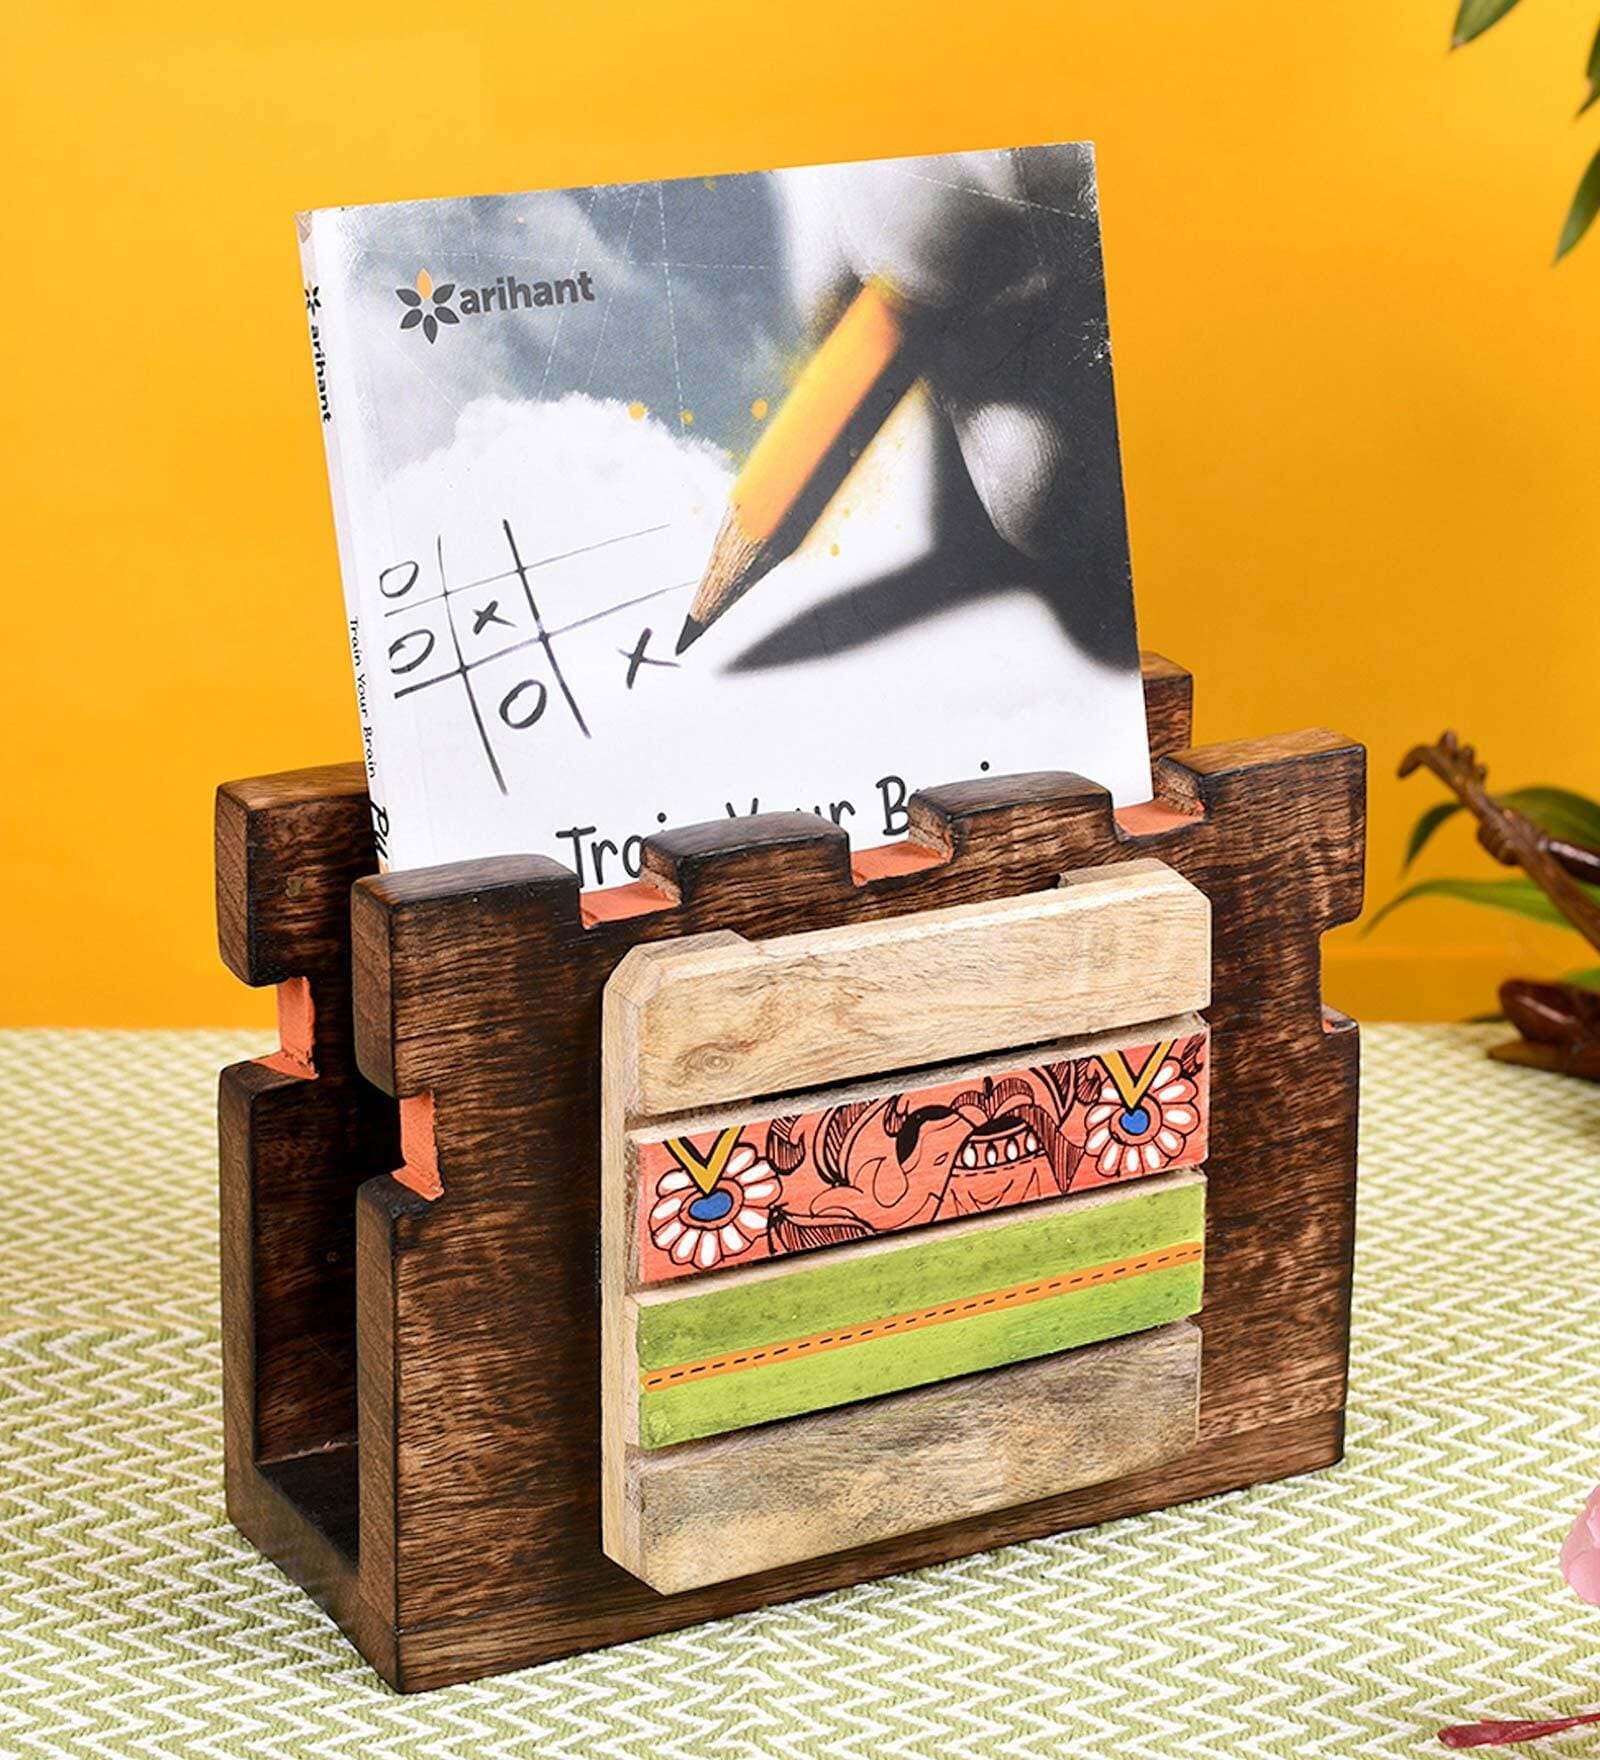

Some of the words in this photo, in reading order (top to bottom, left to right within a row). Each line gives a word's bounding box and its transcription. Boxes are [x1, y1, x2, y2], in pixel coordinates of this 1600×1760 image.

[459, 271, 596, 316] arihant
[311, 324, 332, 424] arihant
[350, 617, 362, 666] Train
[356, 673, 369, 718] Your
[363, 726, 377, 778] Brain
